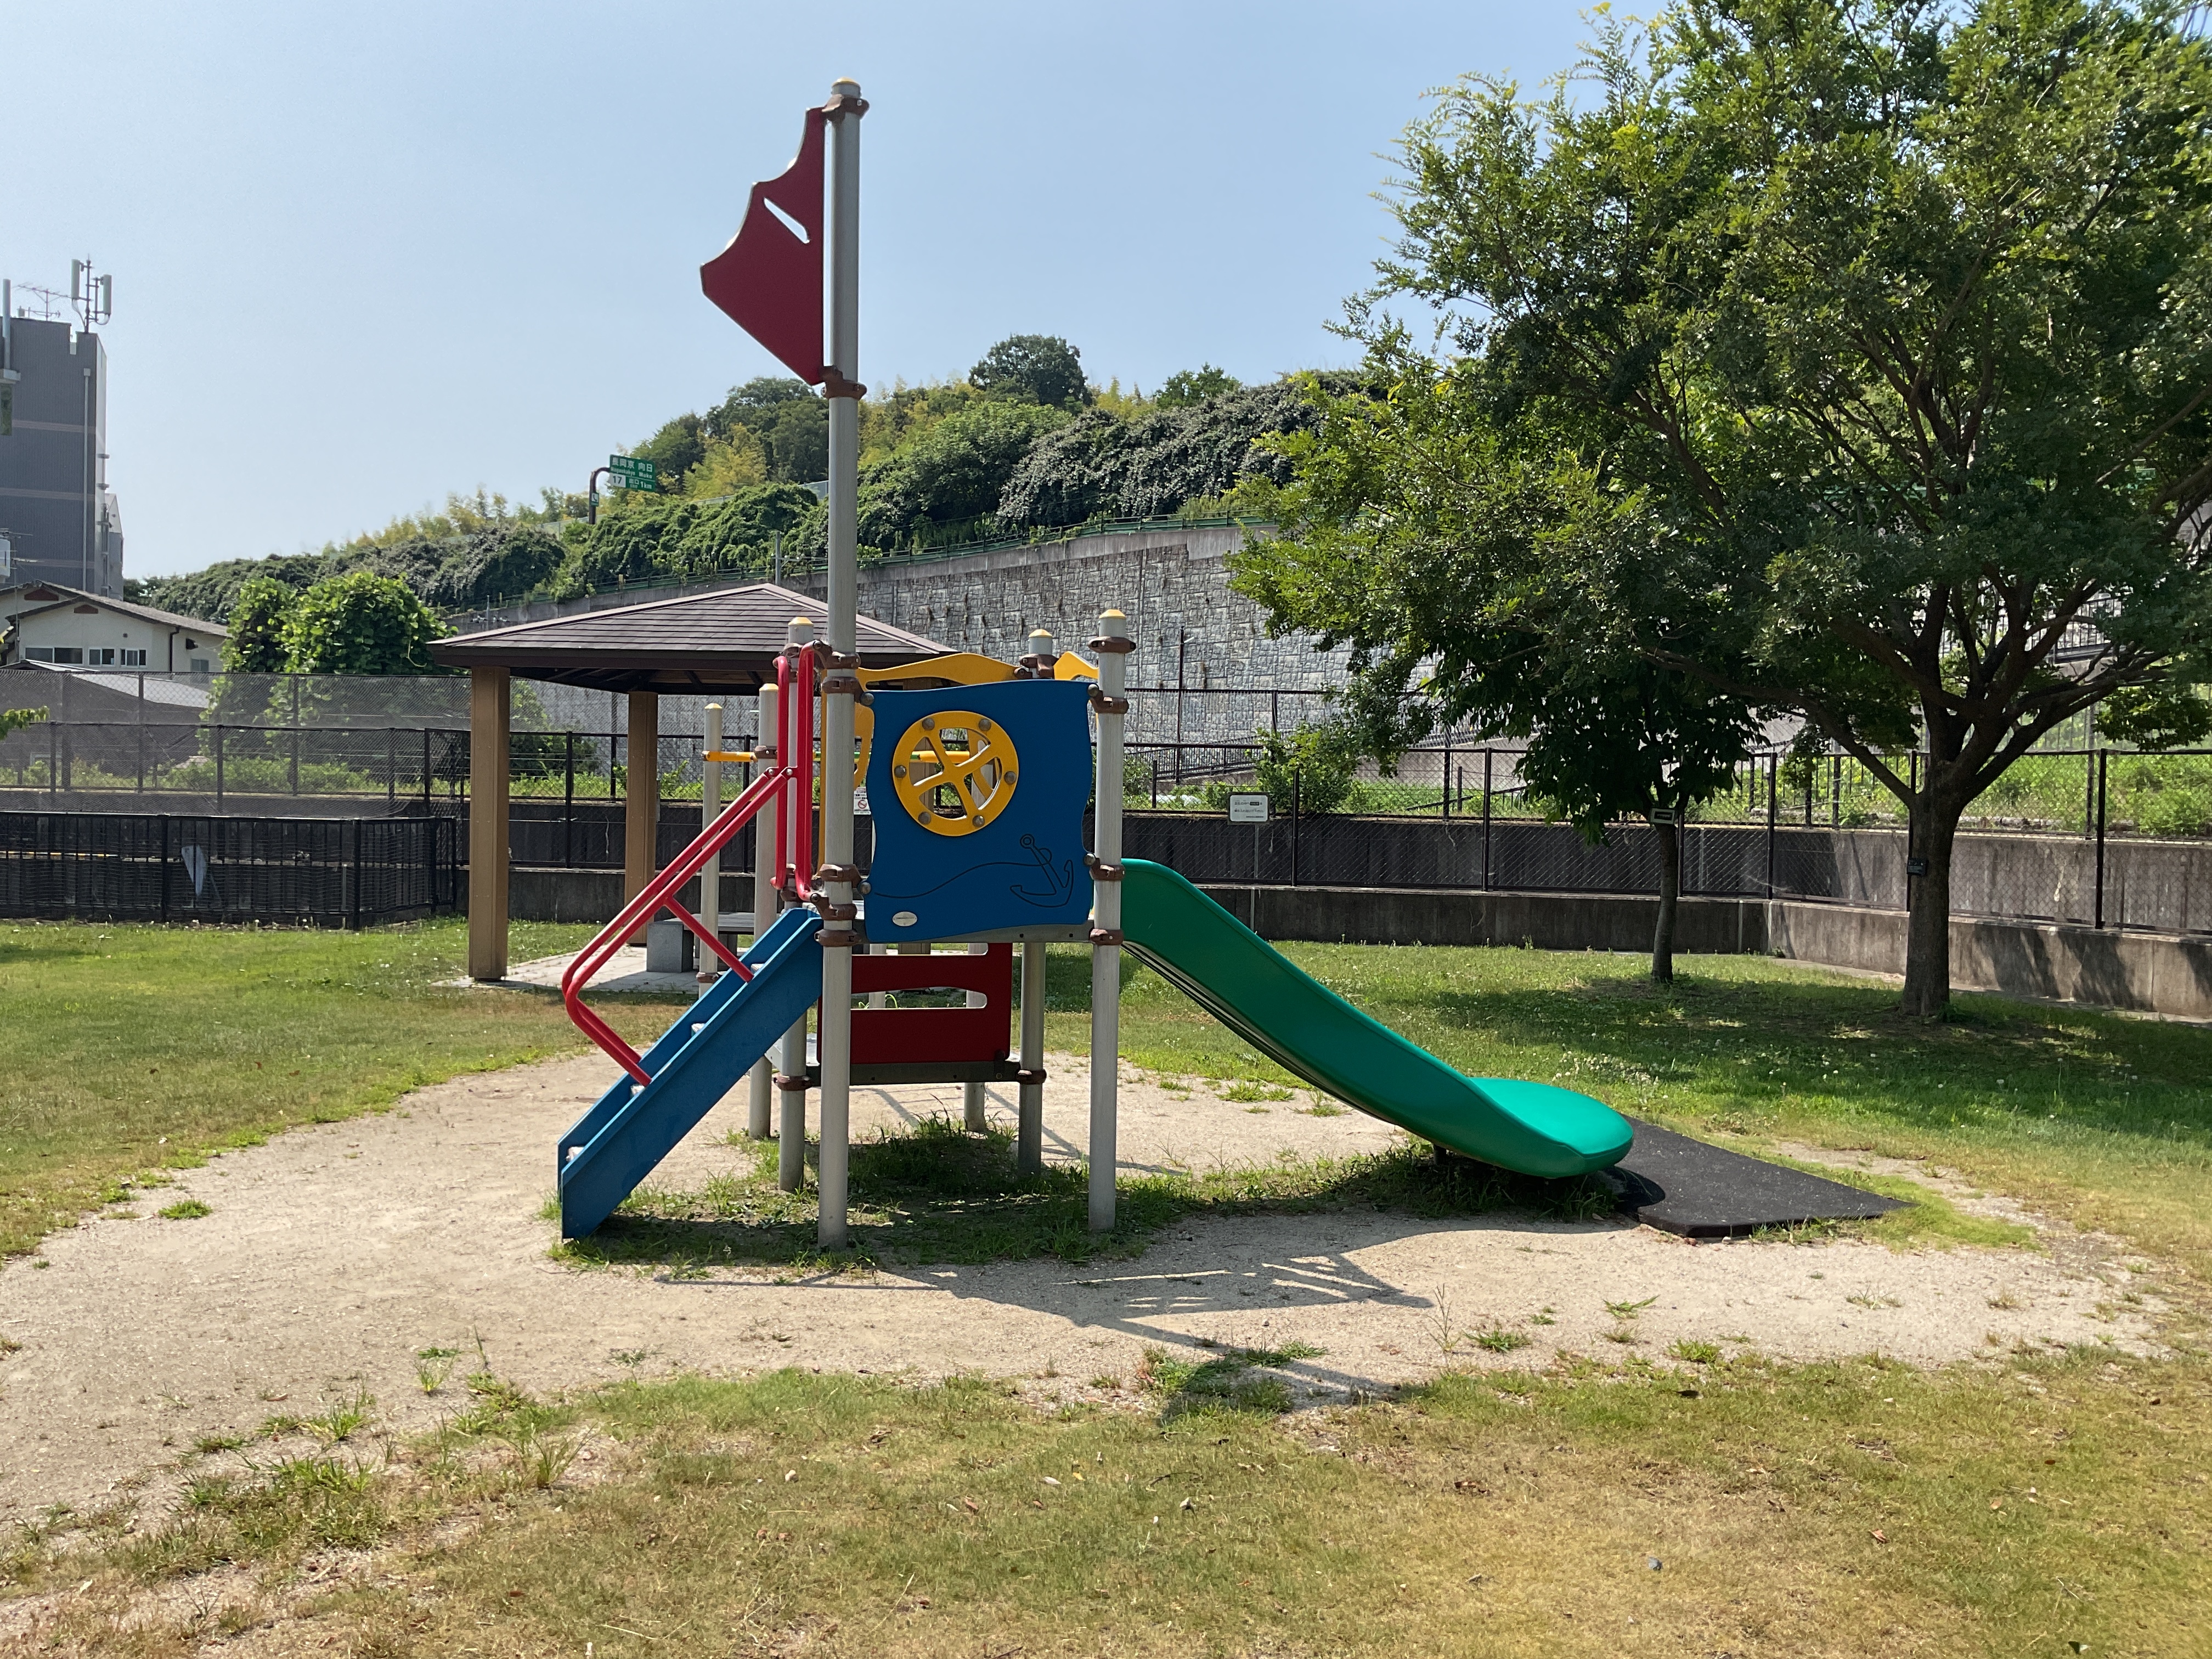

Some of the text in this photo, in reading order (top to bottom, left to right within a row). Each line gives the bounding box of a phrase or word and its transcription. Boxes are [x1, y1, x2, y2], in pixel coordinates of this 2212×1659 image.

[612, 457, 652, 472] 長岡京 向日
[613, 476, 622, 484] 17
